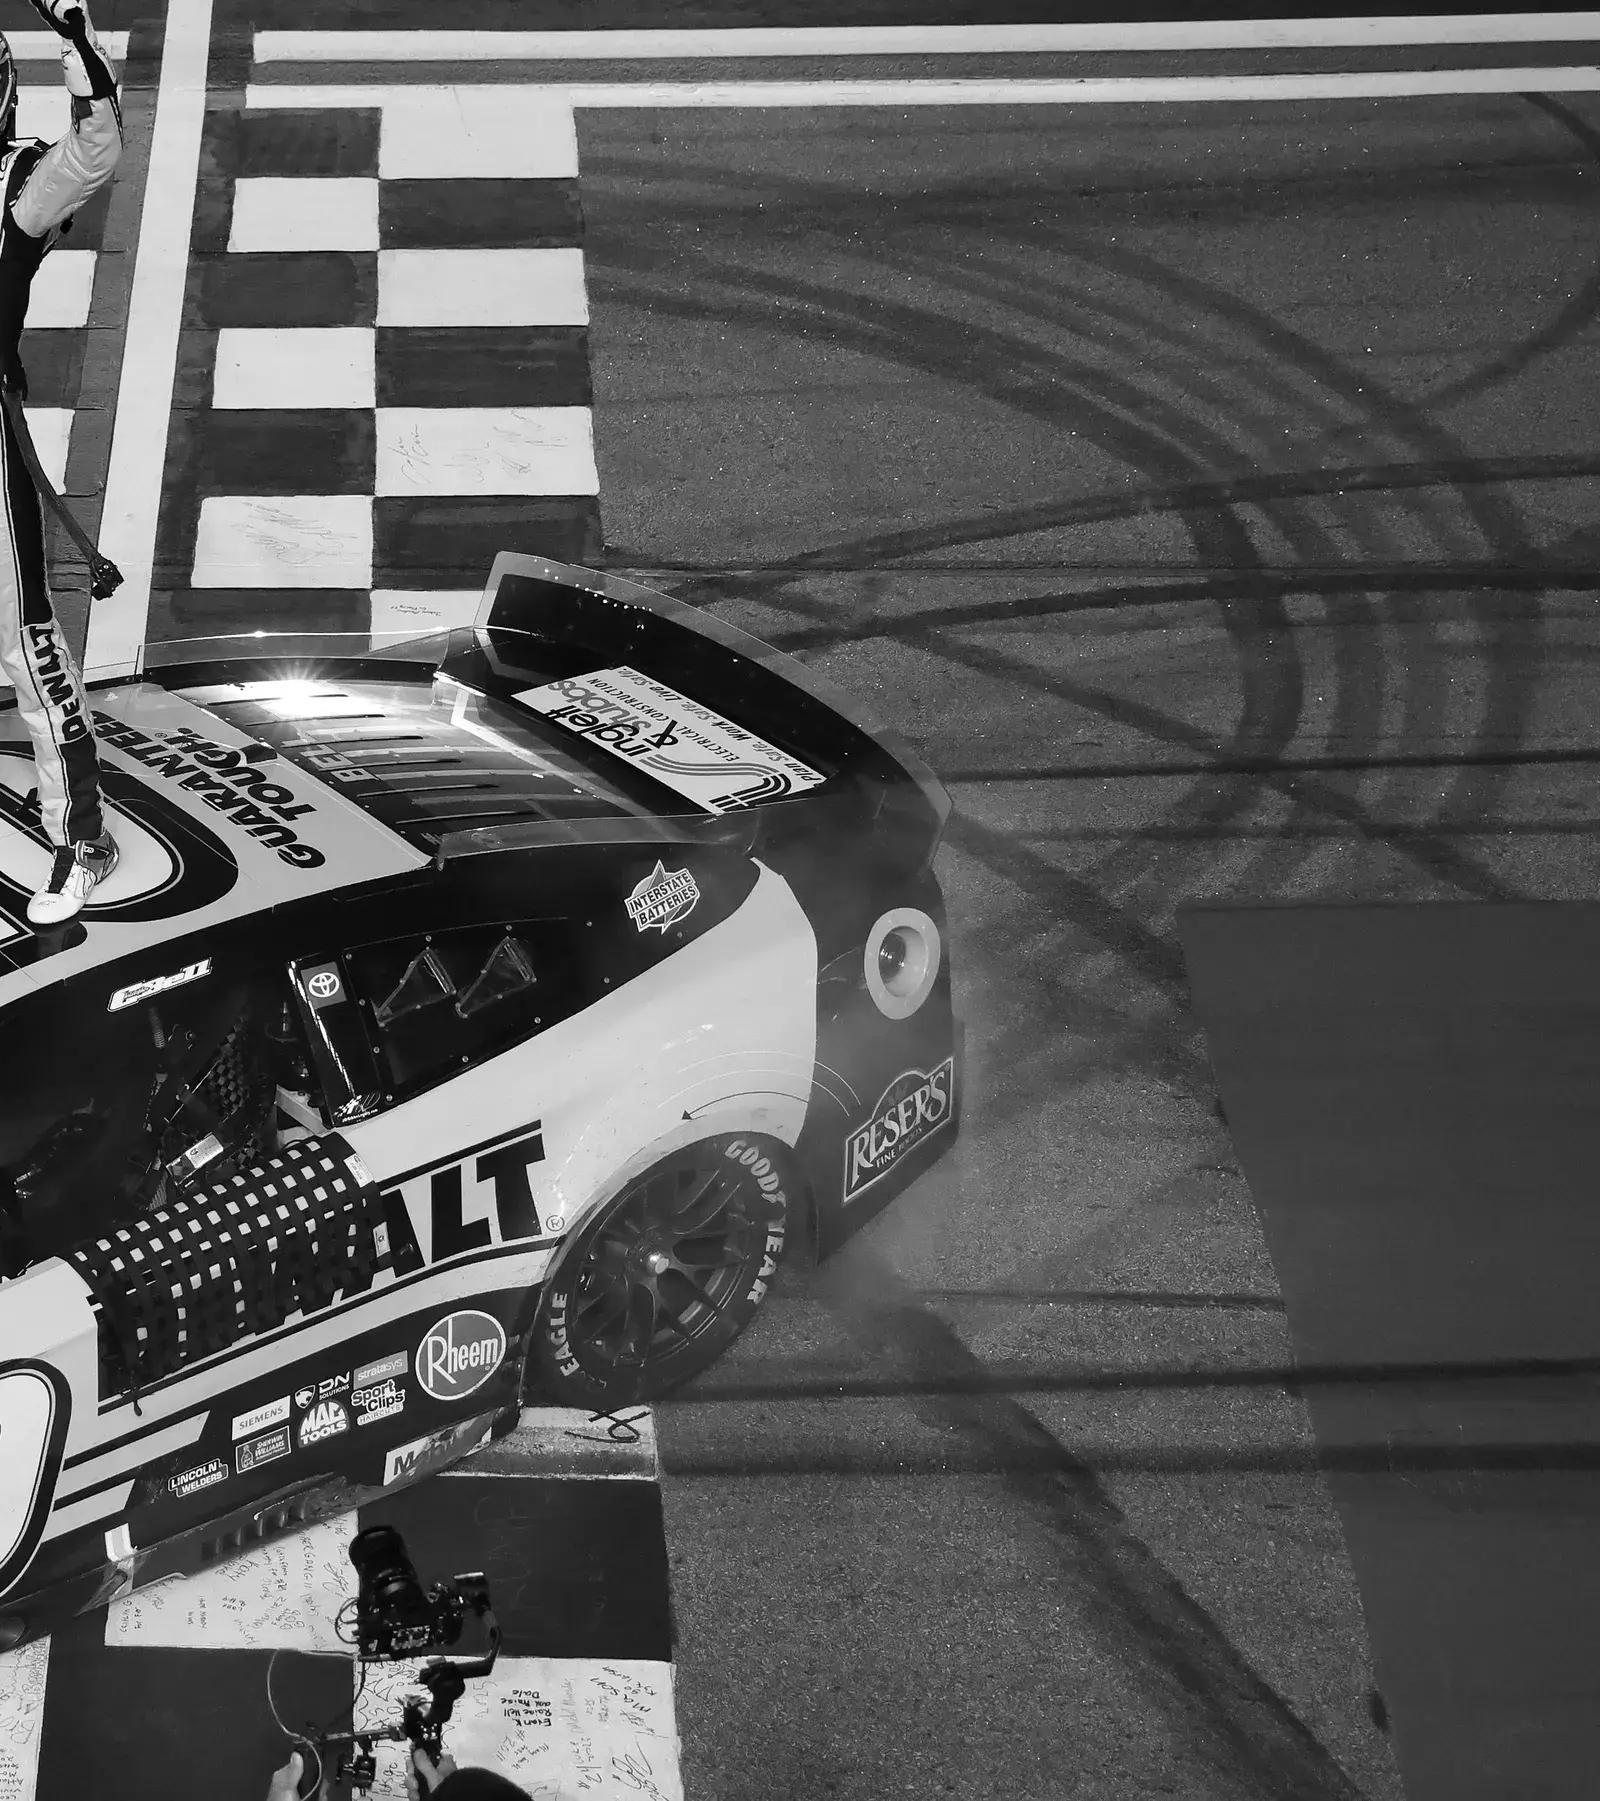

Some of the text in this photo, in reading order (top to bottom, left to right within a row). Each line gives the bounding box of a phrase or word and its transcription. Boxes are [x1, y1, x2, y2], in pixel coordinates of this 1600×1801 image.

[650, 684, 683, 702] Live
[587, 678, 741, 762] ELECTRICAL CONSTRUCTION
[720, 724, 753, 744] Work
[796, 768, 822, 784] Plan
[629, 871, 693, 914] INTERSTATE
[639, 885, 698, 926] BATTERIES
[876, 1148, 897, 1168] FINE
[550, 1293, 580, 1377] EAGLE
[427, 1318, 498, 1389] Rheem
[357, 1358, 403, 1381] stratasys
[318, 1371, 350, 1394] DN
[319, 1384, 350, 1400] SOLUTIONS
[352, 1380, 395, 1406] Sport
[367, 1389, 406, 1414] Clips
[239, 1406, 284, 1430] SIEMENS
[301, 1402, 347, 1436] MAC
[358, 1404, 402, 1424] HAIRCUTS
[301, 1421, 348, 1445] TOOLS
[255, 1441, 285, 1457] WILLIAMS
[171, 1462, 219, 1491] LINCOLN
[181, 1471, 223, 1494] WELDERS
